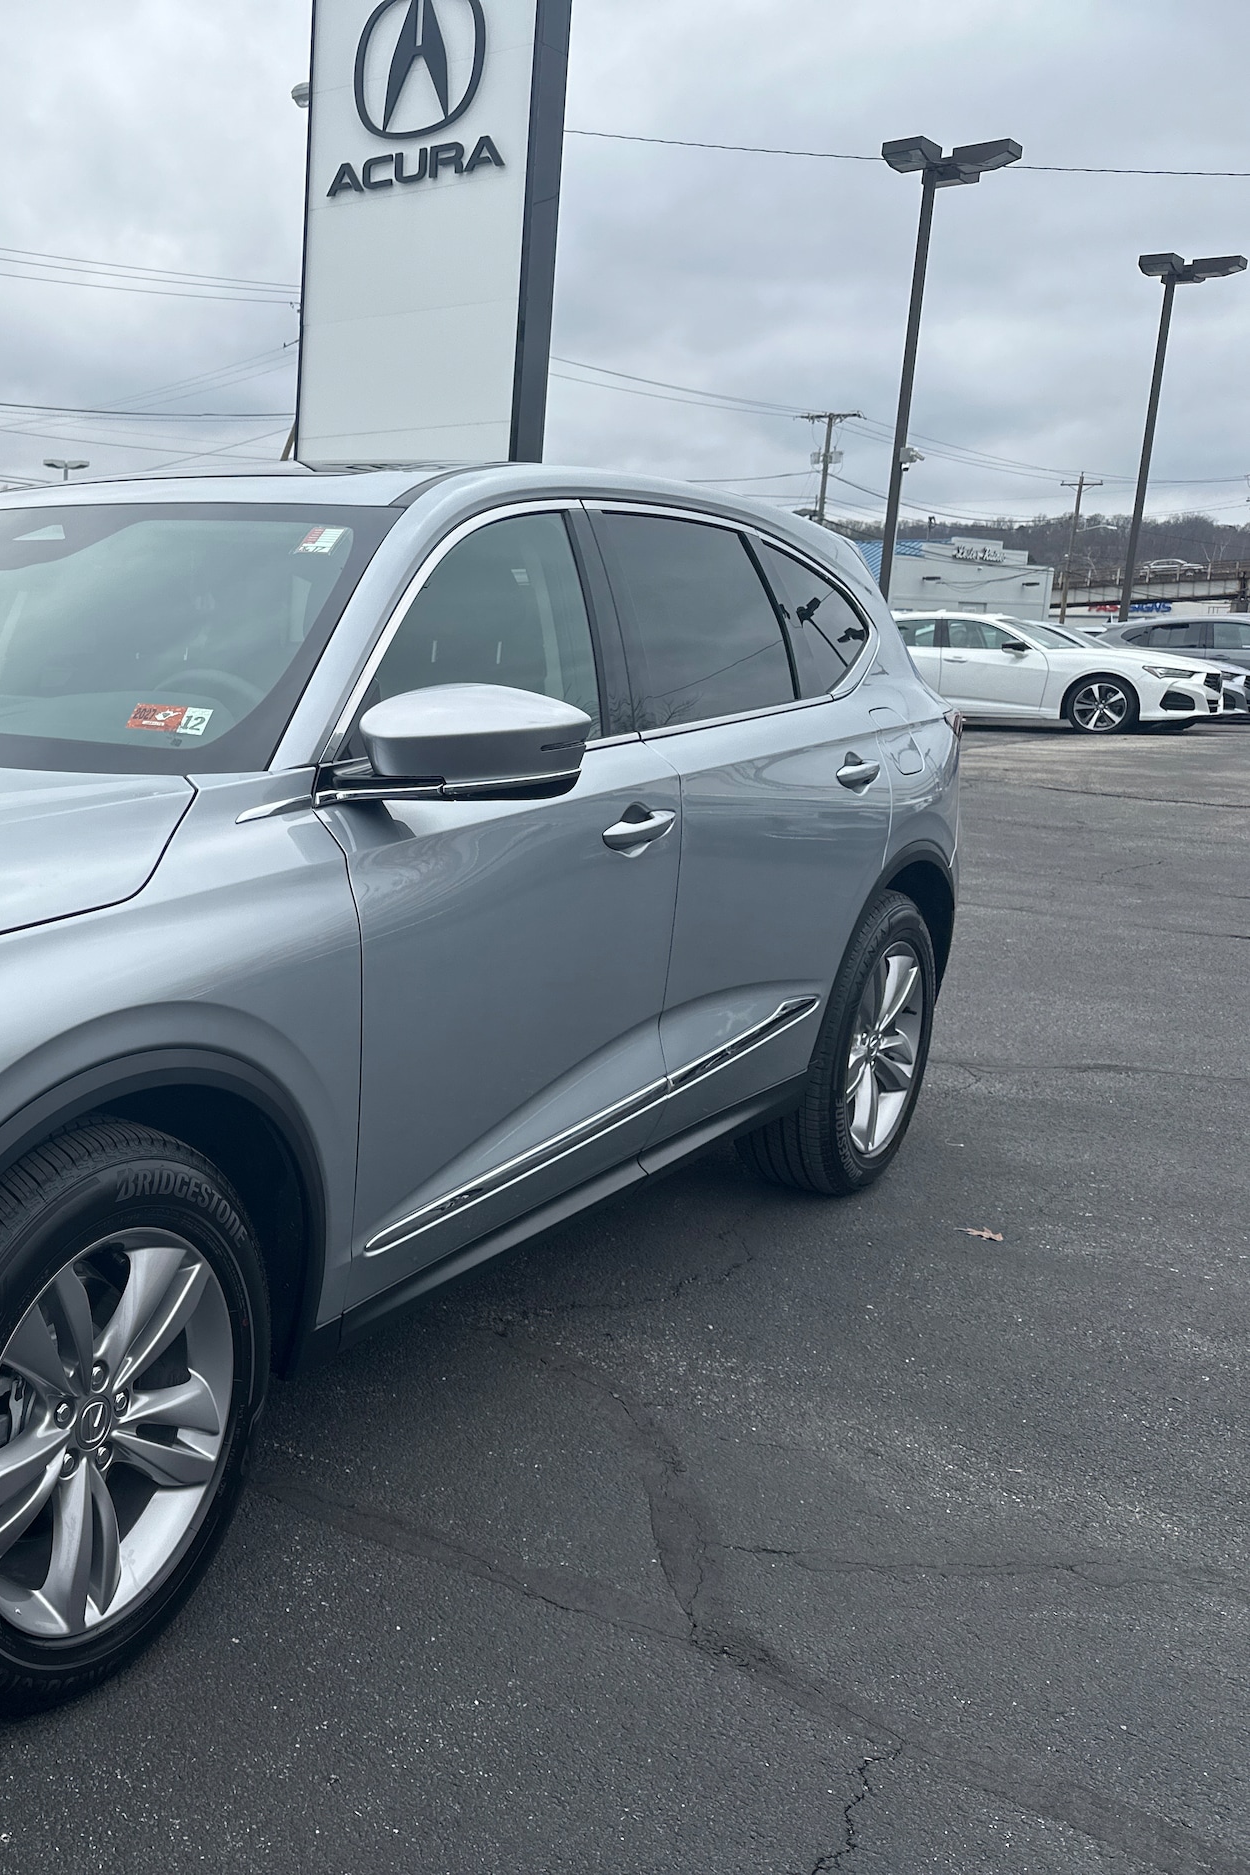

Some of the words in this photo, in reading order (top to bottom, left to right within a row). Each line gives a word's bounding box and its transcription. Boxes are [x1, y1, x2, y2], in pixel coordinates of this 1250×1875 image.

[326, 135, 505, 197] ACURA
[132, 707, 157, 720] 2027
[180, 715, 206, 731] 12
[115, 1167, 248, 1248] BRIDGESTONE
